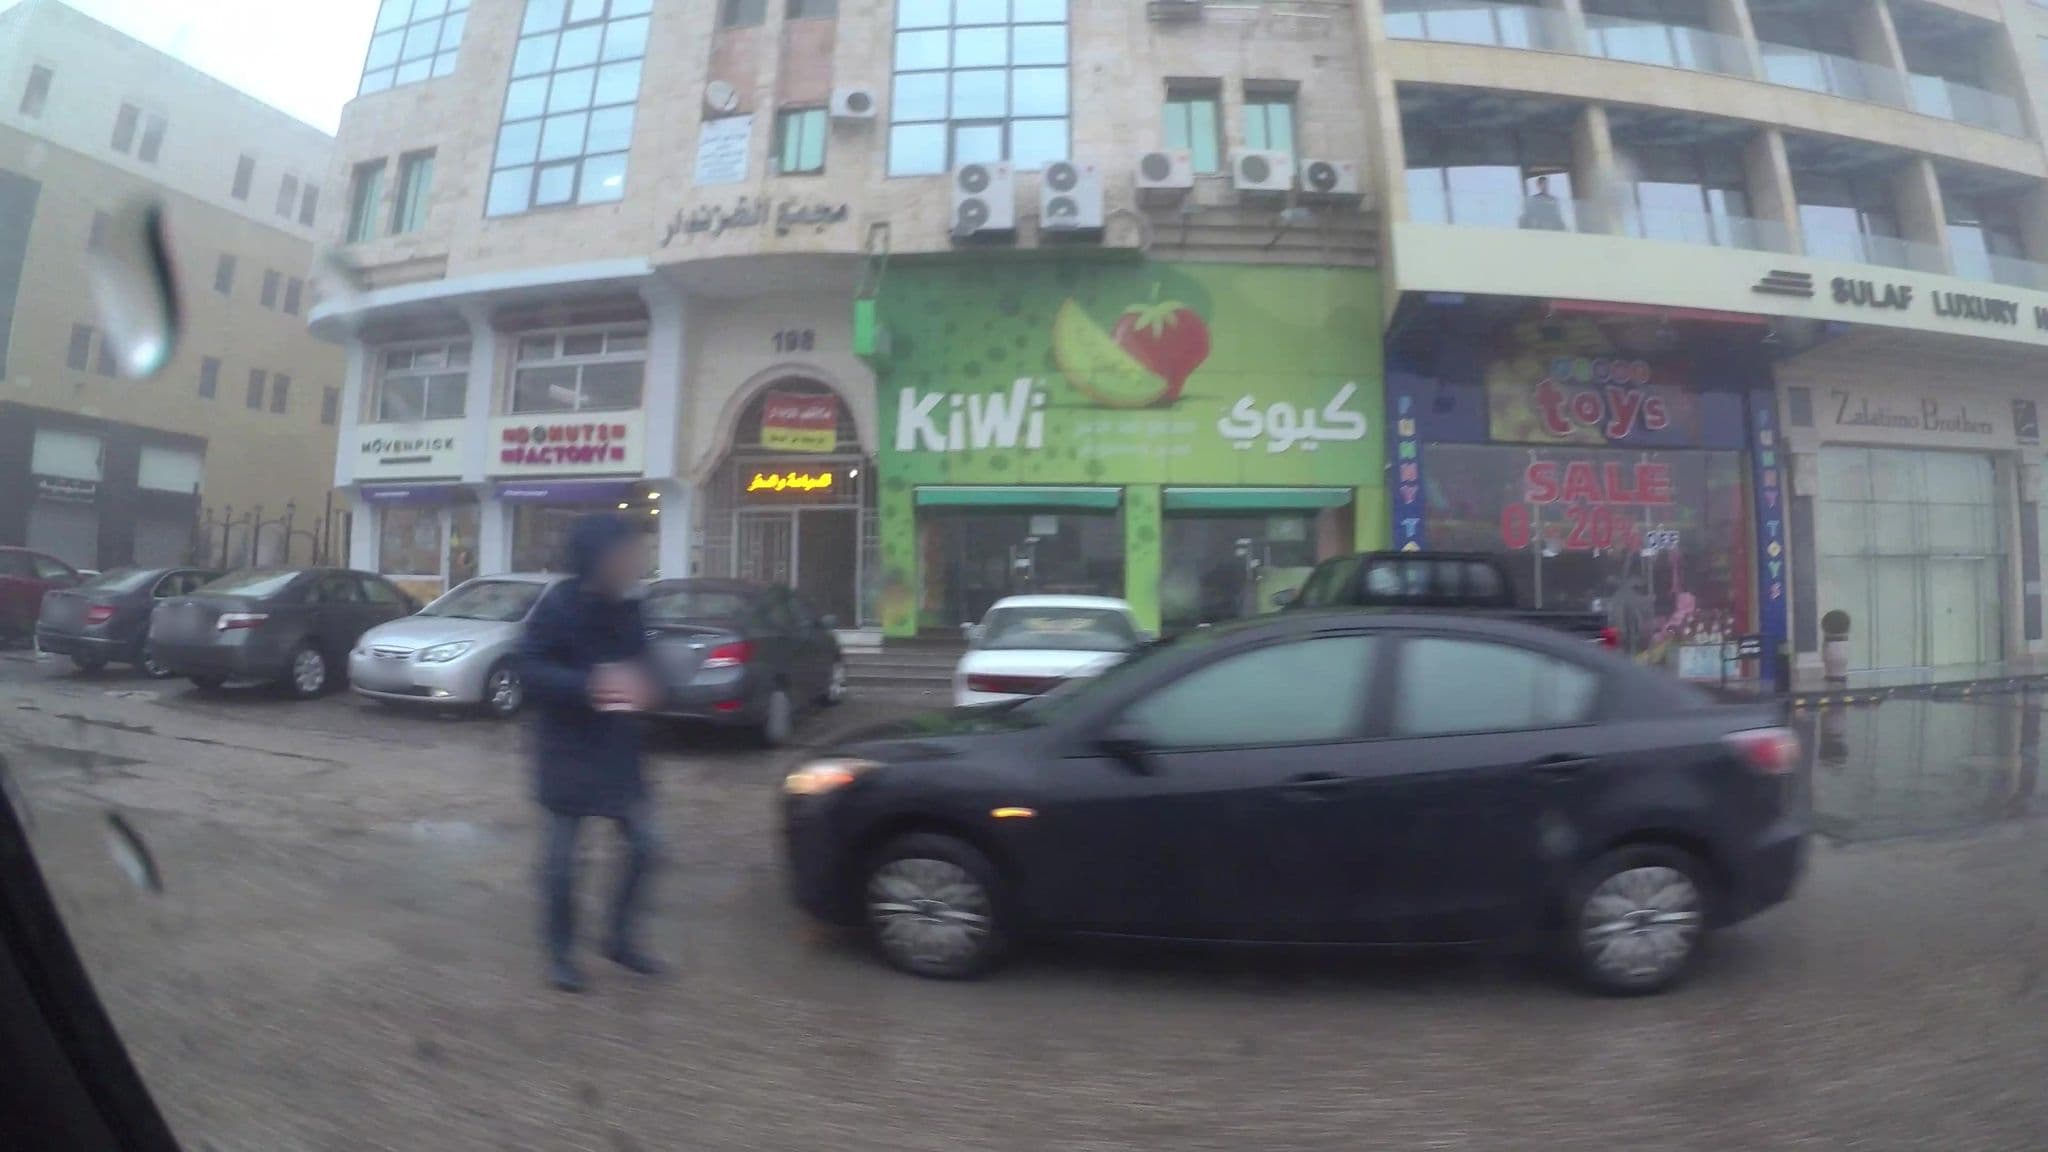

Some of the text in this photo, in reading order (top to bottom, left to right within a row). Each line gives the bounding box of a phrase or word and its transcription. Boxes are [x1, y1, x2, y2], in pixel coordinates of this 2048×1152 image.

[1831, 277, 1913, 310] SULAF
[1931, 290, 2018, 325] LUXURY
[895, 377, 1047, 452] KiWi
[1216, 381, 1368, 453] كيوي
[1535, 377, 1669, 438] toys
[1921, 397, 1994, 435] Brothers
[1525, 460, 1672, 505] SALE
